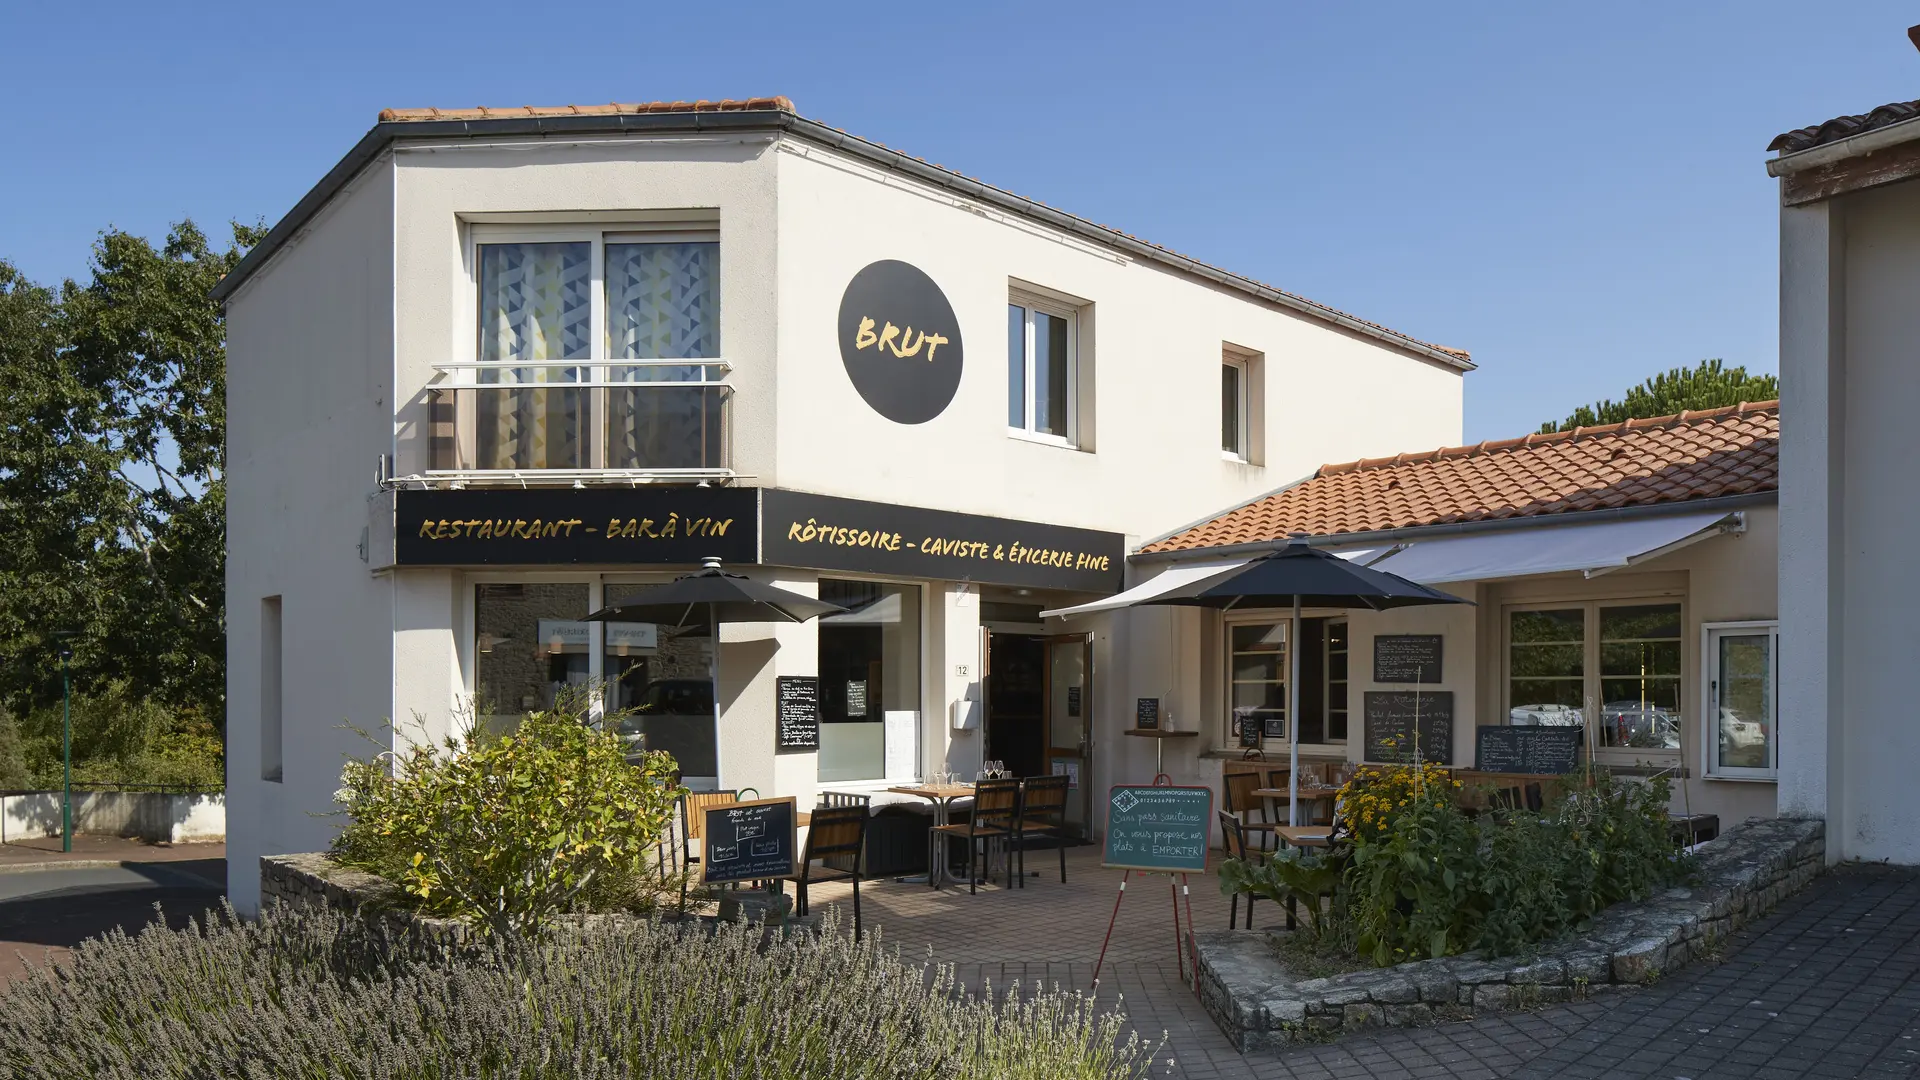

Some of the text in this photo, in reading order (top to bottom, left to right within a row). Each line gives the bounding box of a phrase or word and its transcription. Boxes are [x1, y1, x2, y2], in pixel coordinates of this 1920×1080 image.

[856, 317, 949, 361] BRUT
[419, 518, 582, 539] RESTAURANT
[607, 518, 659, 538] BAR
[661, 512, 680, 537] À
[686, 518, 734, 538] VIN
[788, 518, 902, 551] RÔTISSOIRE
[921, 537, 989, 559] CAVISTE
[993, 544, 1005, 561] &
[1009, 543, 1073, 568] ÉPICERIE
[1075, 553, 1110, 572] FINE
[959, 666, 967, 674] 12
[1112, 807, 1201, 826] Sans pass sanitaire
[1113, 828, 1203, 844] On vous propose nos
[1112, 839, 1134, 858] plats
